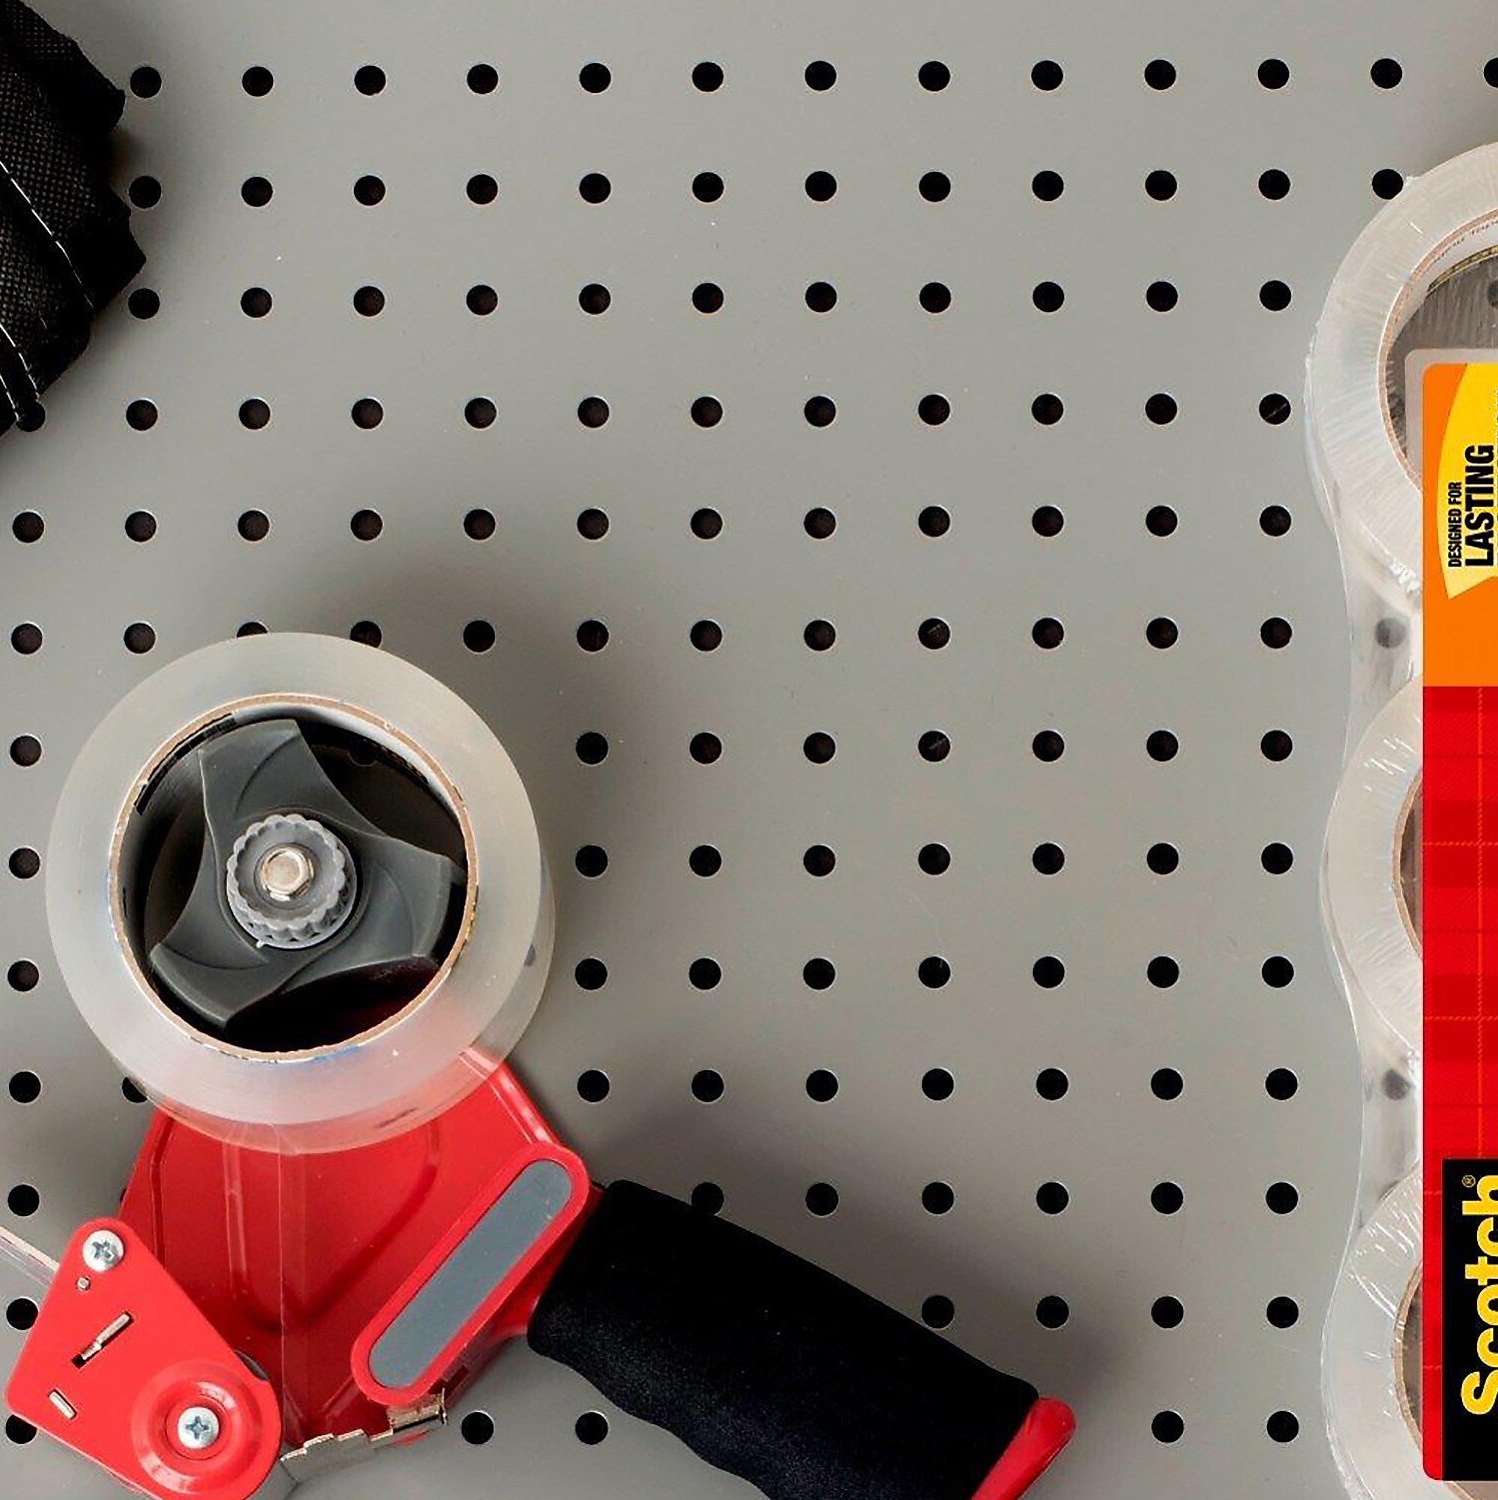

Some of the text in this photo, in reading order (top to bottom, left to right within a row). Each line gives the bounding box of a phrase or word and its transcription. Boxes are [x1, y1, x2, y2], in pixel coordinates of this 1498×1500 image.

[1448, 482, 1462, 567] DESIGNED FOR
[1465, 445, 1494, 567] LASTING
